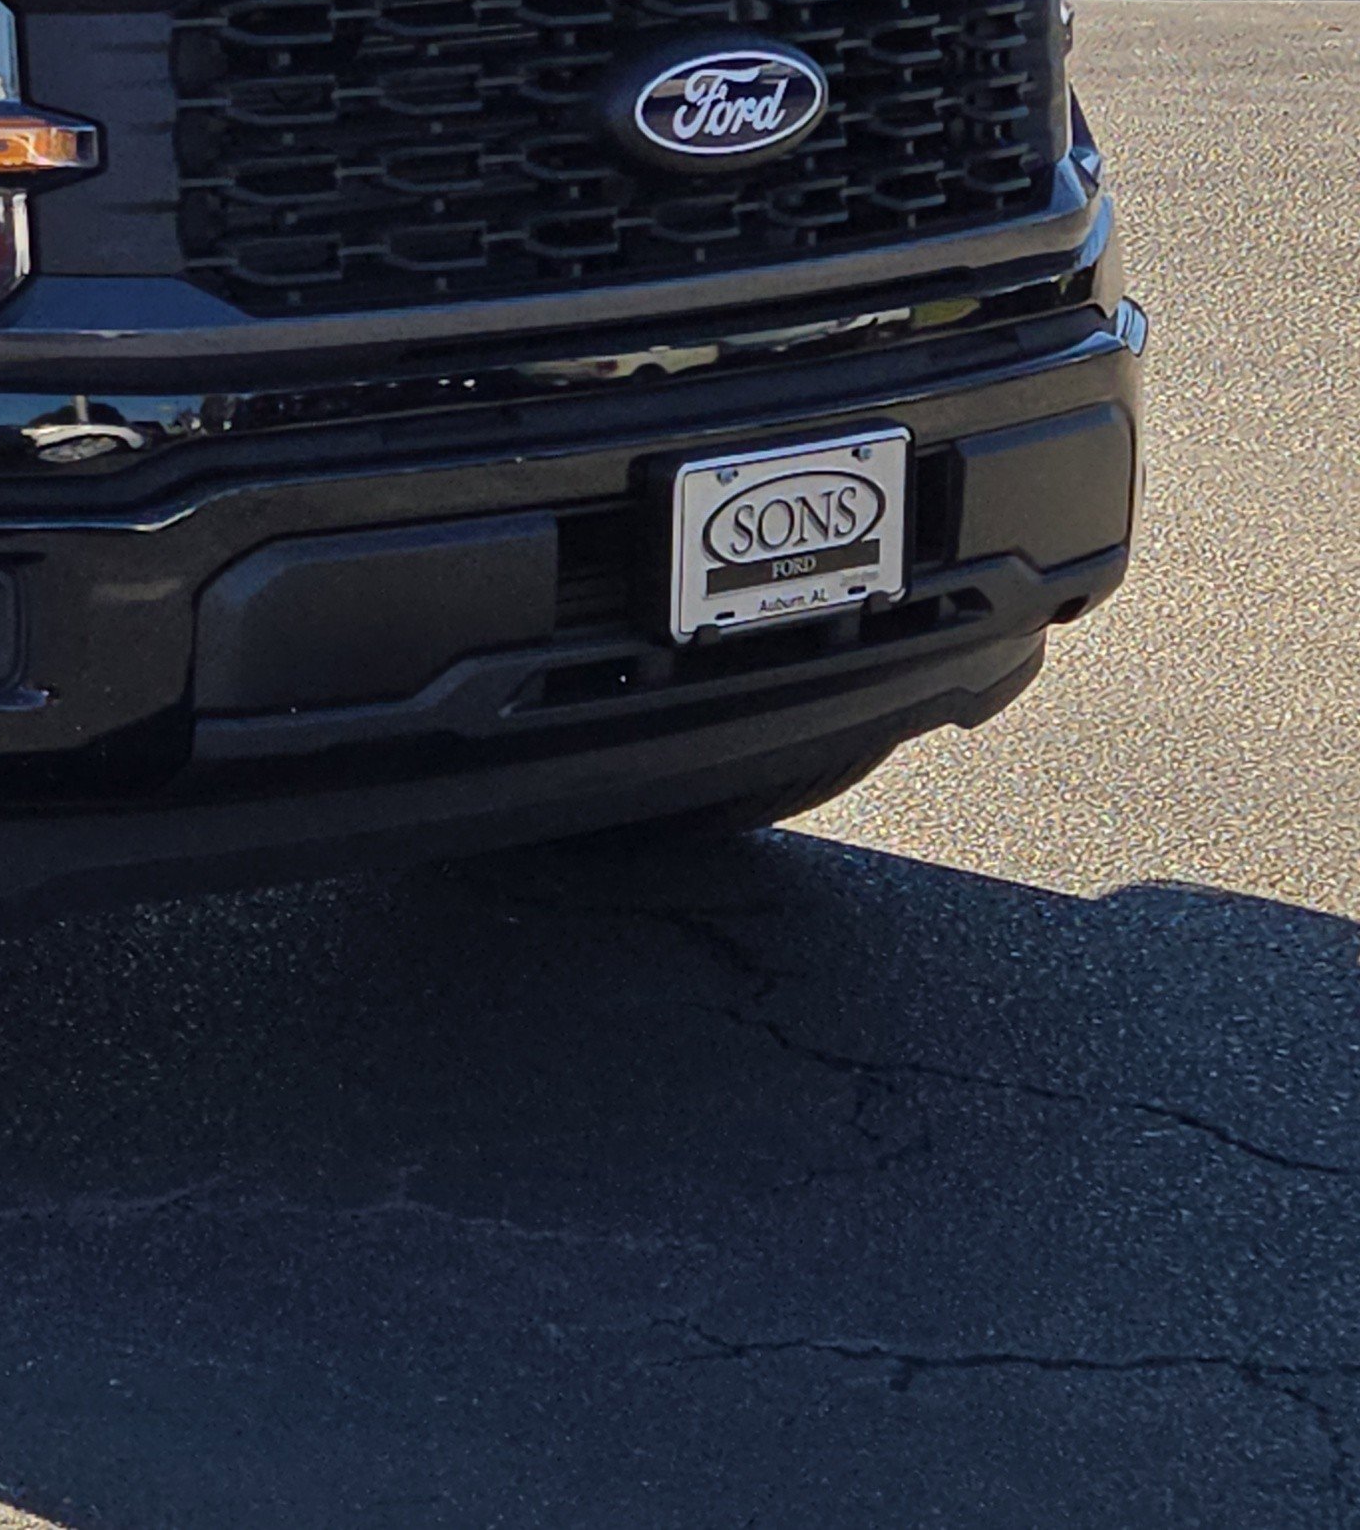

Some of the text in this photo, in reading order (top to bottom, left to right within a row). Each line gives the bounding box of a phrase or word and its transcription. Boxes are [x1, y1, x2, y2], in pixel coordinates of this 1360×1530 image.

[672, 65, 790, 140] Ford
[730, 486, 857, 556] SONS
[771, 555, 817, 579] FORD
